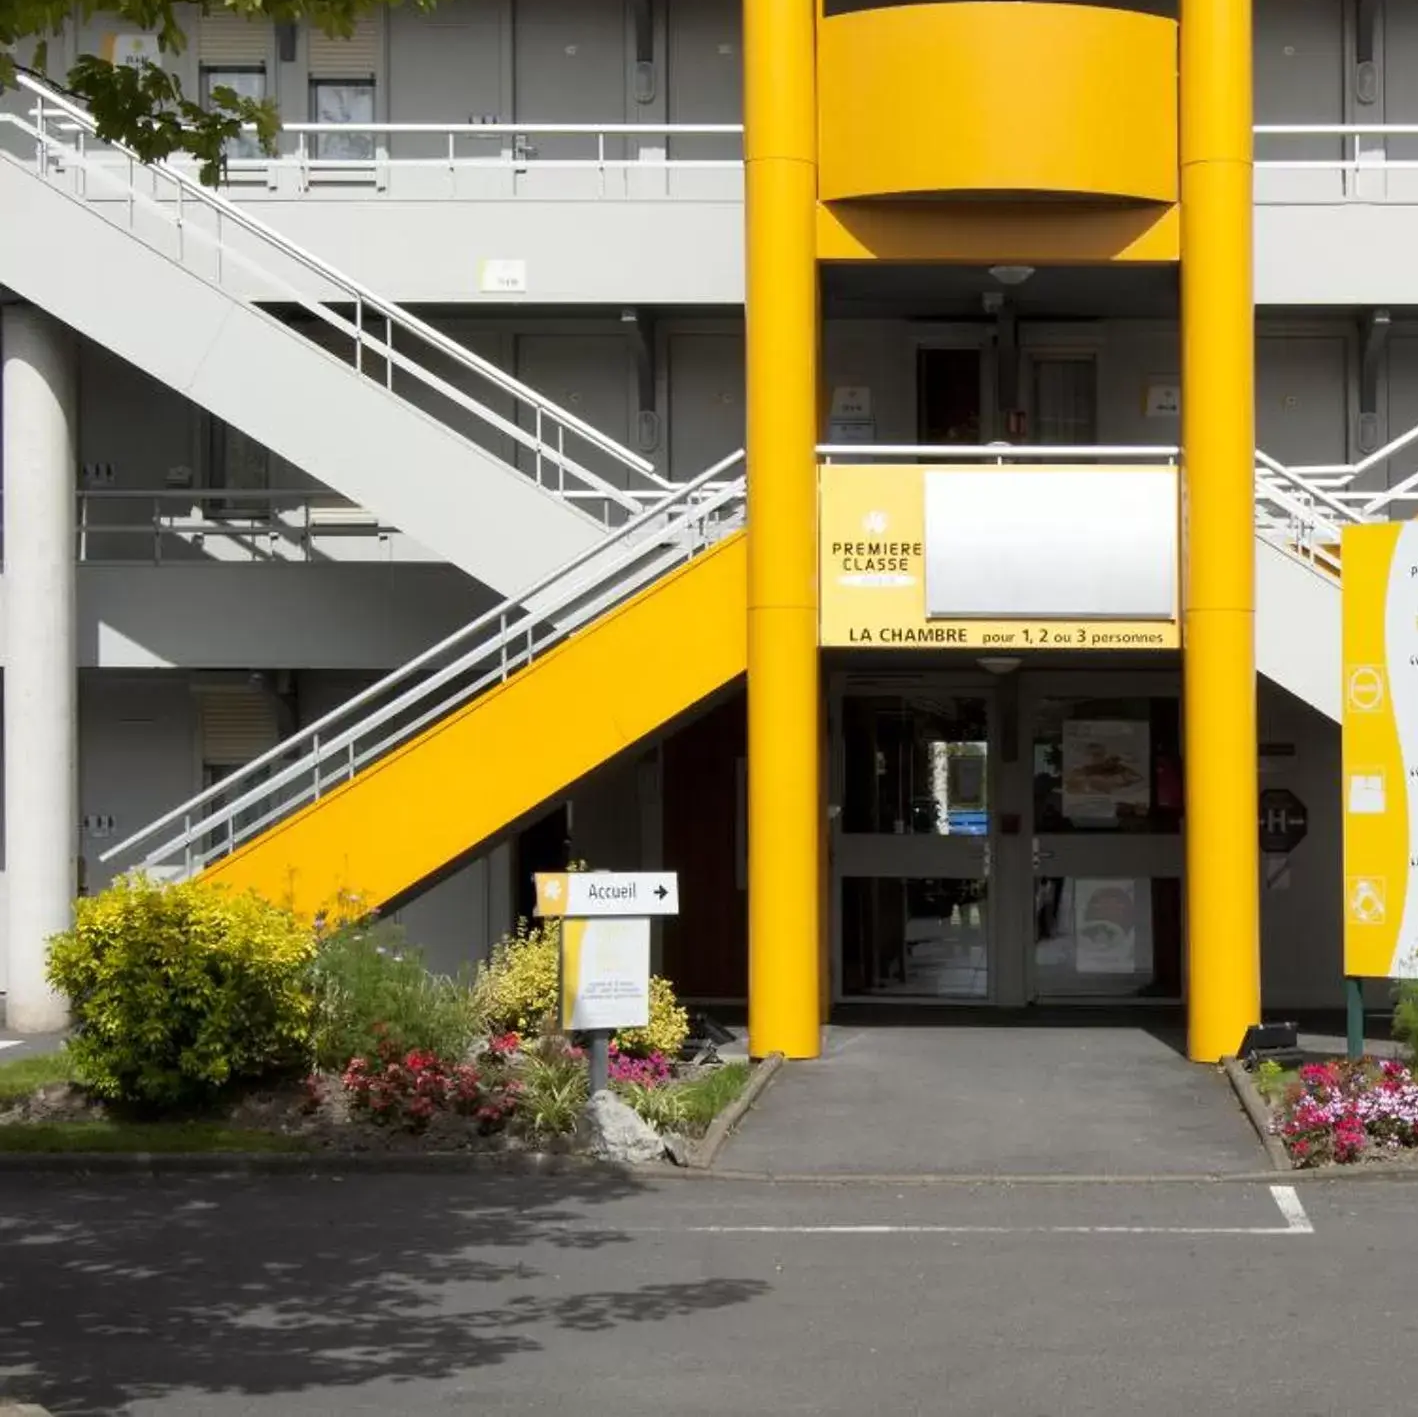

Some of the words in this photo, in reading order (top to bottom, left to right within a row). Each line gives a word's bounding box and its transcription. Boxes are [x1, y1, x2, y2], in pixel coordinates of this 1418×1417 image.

[832, 542, 923, 557] PREMIERE
[842, 557, 909, 572] CLASSE
[849, 628, 873, 643] LA
[879, 627, 968, 643] CHAMBRE
[982, 632, 1015, 646] pour
[1039, 629, 1048, 644] 2
[1053, 633, 1072, 644] ou
[1077, 629, 1086, 644] 3
[1091, 633, 1164, 646] personnes
[588, 883, 637, 900] Accueil
